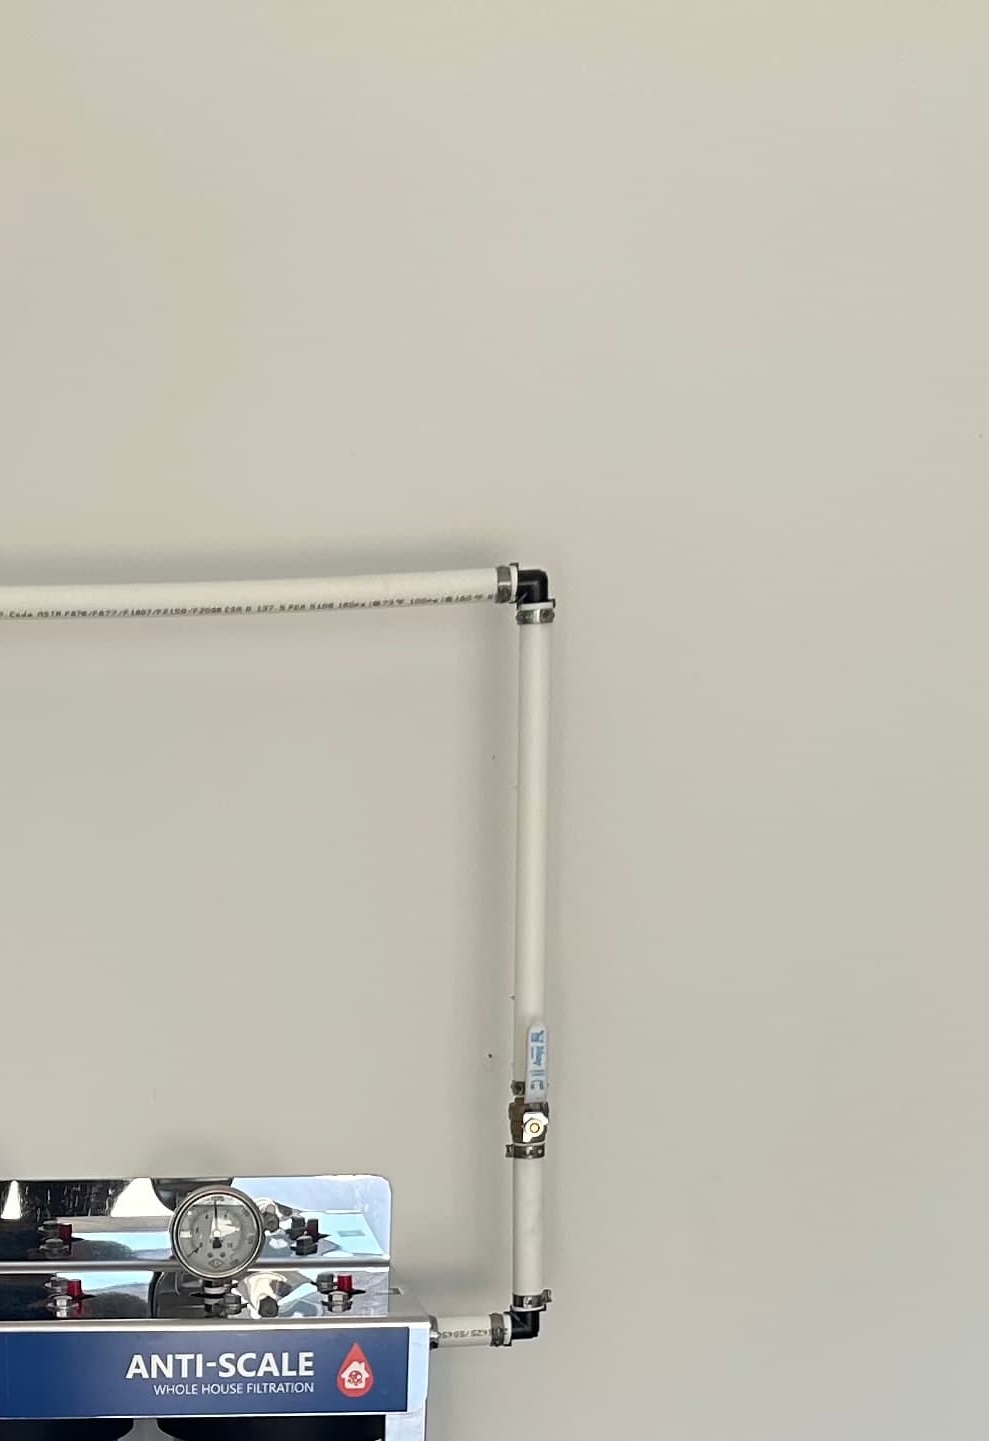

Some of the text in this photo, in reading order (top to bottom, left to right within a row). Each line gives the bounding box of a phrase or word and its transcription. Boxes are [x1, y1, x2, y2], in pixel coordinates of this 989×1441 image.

[125, 1352, 314, 1379] ANTI-SCALE
[153, 1382, 314, 1395] WHOLE HOUSE FILTRATION
